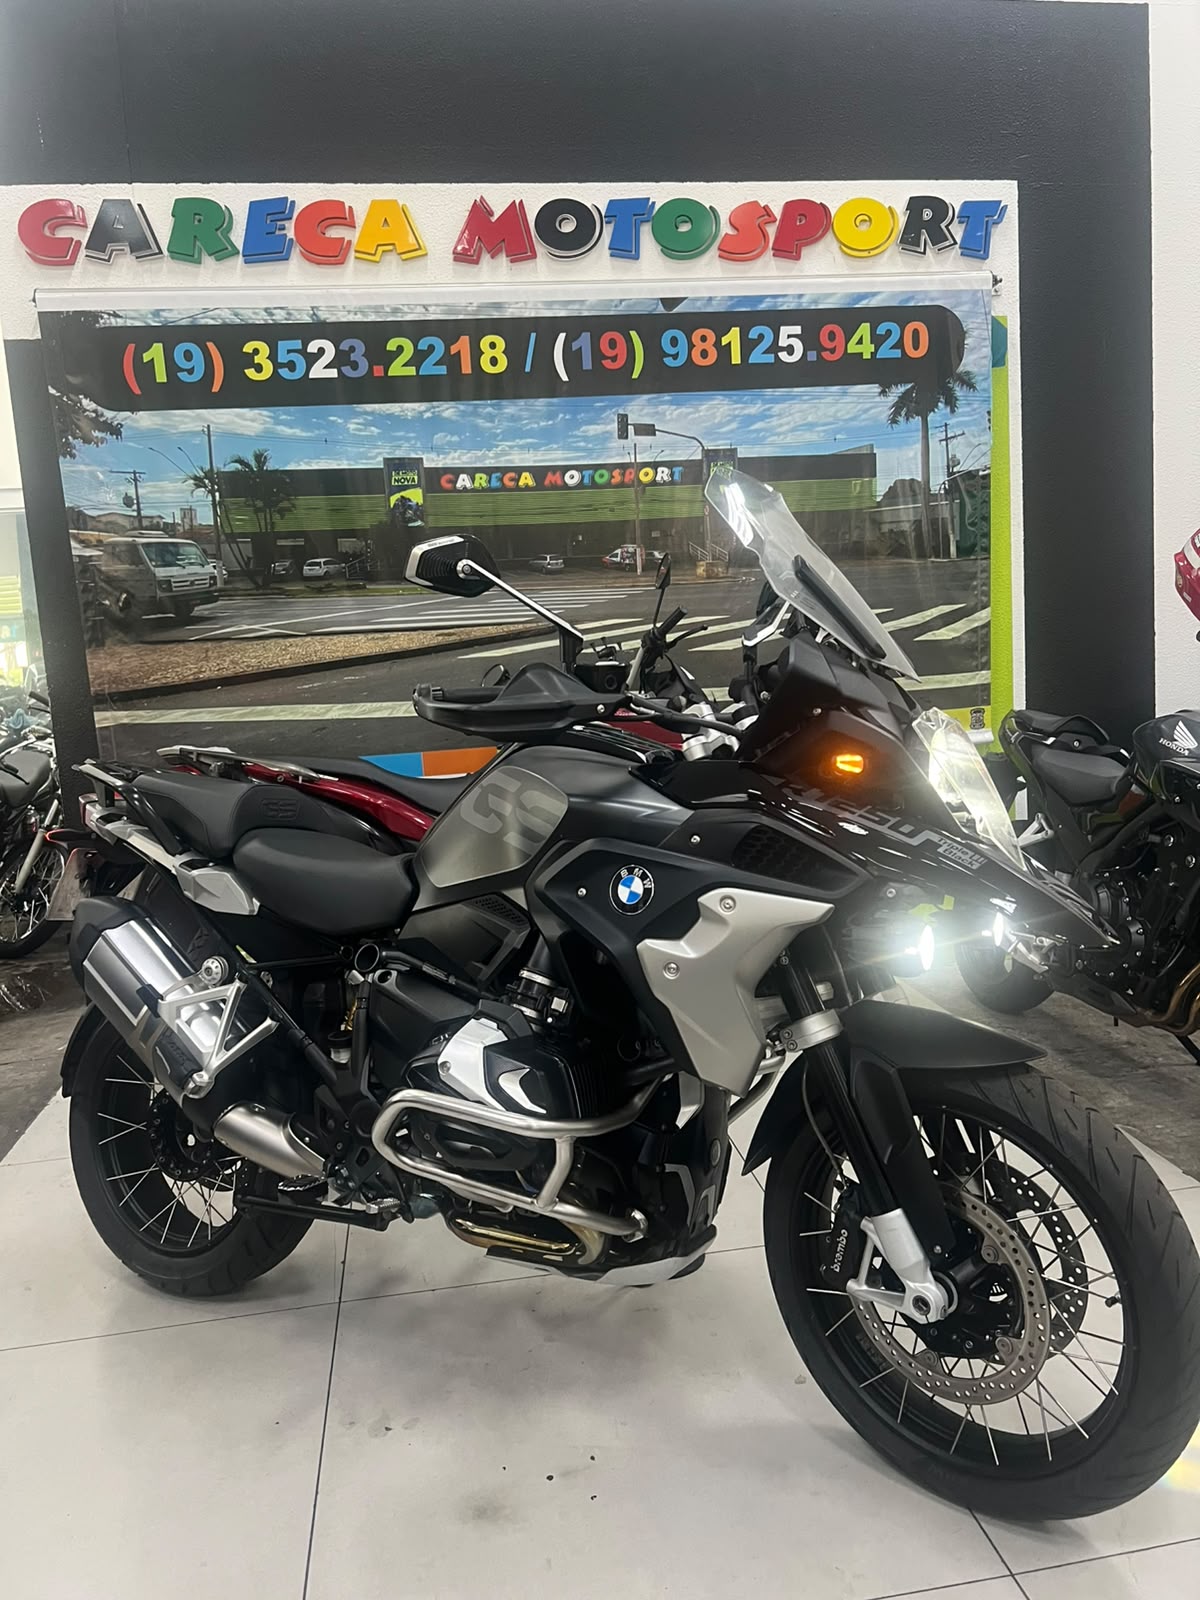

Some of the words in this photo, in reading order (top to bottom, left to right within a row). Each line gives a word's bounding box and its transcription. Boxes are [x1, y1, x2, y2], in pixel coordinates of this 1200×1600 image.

[18, 197, 429, 265] CARECA
[452, 195, 1007, 265] MOTOSPORT
[122, 342, 225, 394] (19)
[243, 335, 508, 380] 3523.2218
[553, 331, 644, 381] (19)
[660, 321, 930, 367] 98125.9420
[393, 476, 417, 485] NOVA
[440, 472, 536, 490] CARECA
[543, 467, 684, 487] MOTOSPORT
[1159, 738, 1190, 756] HONDA
[937, 837, 970, 856] Triple
[942, 849, 977, 868] Black
[620, 867, 653, 889] BMW
[830, 1229, 849, 1273] brembo
